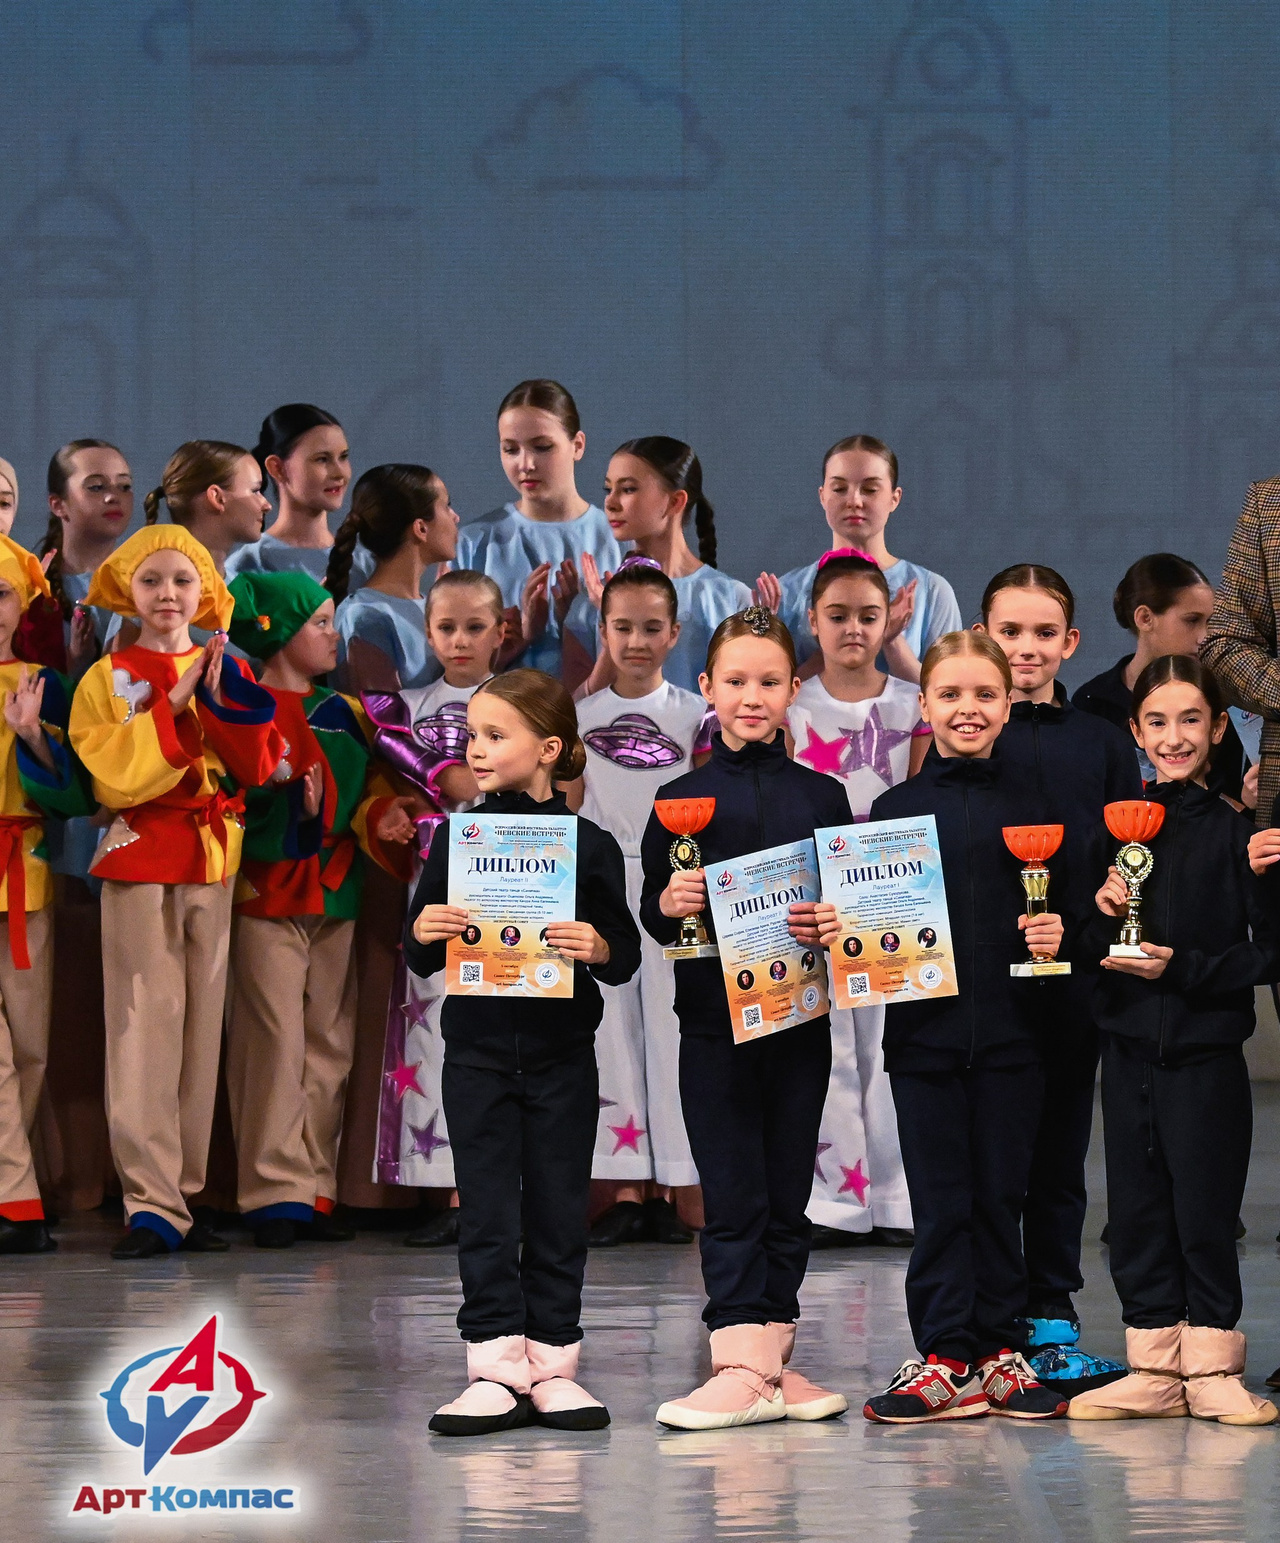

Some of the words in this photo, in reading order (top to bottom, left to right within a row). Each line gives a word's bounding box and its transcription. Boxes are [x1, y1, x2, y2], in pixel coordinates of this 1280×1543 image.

[467, 857, 557, 875] ДИПЛОМ
[840, 860, 923, 888] ДИПЛОМ
[872, 883, 896, 891] Лауреат
[730, 885, 805, 922] ДИПЛОМ
[758, 913, 778, 922] Лауреат
[920, 1379, 953, 1408] N
[985, 1375, 1014, 1402] N
